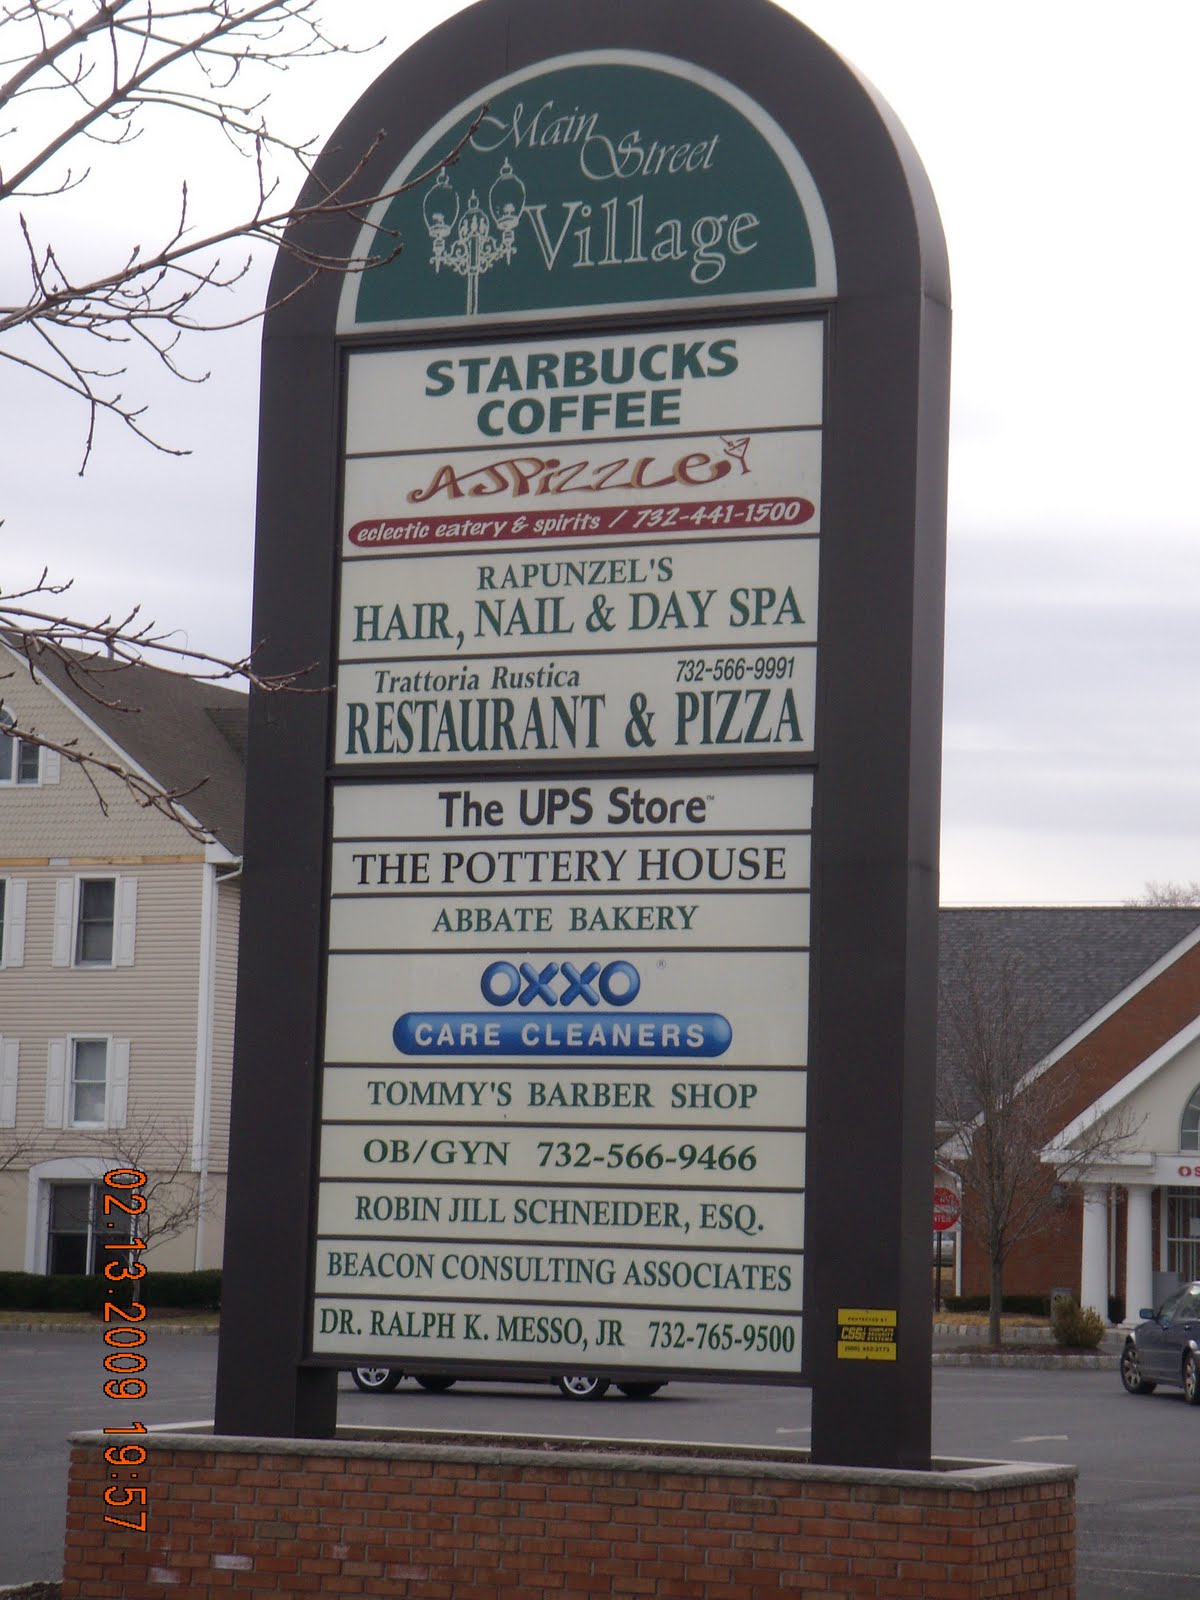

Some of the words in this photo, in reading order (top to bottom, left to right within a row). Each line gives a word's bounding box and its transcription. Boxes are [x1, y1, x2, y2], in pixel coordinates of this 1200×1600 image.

[468, 100, 599, 152] Main
[579, 130, 720, 181] Street
[523, 193, 760, 284] Village
[425, 339, 739, 397] STARBUCKS
[476, 388, 682, 437] COFFEE
[357, 521, 429, 541] eclectic
[435, 519, 507, 537] eatery
[511, 516, 528, 533] &
[533, 512, 601, 536] spirits
[632, 501, 800, 530] 732-441-1500
[478, 557, 672, 590] RAPUNZEL'S
[353, 603, 464, 650] HAIR,
[475, 597, 574, 636] NAIL
[586, 595, 615, 632] &
[629, 590, 717, 630] DAY
[730, 586, 805, 627] SPA
[374, 664, 479, 693] Trattoria
[491, 663, 579, 689] Rustica
[677, 657, 794, 682] 732-566-9991
[345, 695, 605, 754] RESTAURANT
[625, 693, 656, 748] &
[675, 688, 803, 745] PIZZA
[438, 791, 503, 828] The
[520, 787, 593, 826] UPS
[353, 853, 429, 884] THE
[442, 850, 626, 883] POTTERY
[638, 848, 785, 880] HOUSE
[432, 908, 552, 932] ABBATE
[569, 906, 698, 931] BAKERY
[481, 961, 640, 1007] OXXO
[415, 1022, 501, 1046] CARE
[522, 1021, 704, 1047] CLEANERS
[368, 1081, 511, 1106] TOMMY'S
[528, 1083, 654, 1107] BARBER
[672, 1083, 757, 1108] SHOP
[364, 1140, 509, 1165] OB/GYN
[538, 1142, 756, 1171] 732-566-9466
[356, 1196, 441, 1221] ROBIN
[449, 1198, 505, 1222] JILL
[514, 1199, 689, 1233] SCHNEIDER,
[700, 1204, 763, 1236] ESQ.
[328, 1252, 434, 1278] BEACON
[442, 1255, 615, 1284] CONSULTING
[623, 1261, 791, 1291] ASSOCIATES
[320, 1309, 361, 1335] DR.
[370, 1311, 455, 1338] RALPH
[464, 1315, 488, 1340] K.
[496, 1316, 587, 1351] MESSO,
[596, 1320, 624, 1346] JR
[649, 1322, 794, 1352] 732-765-9500
